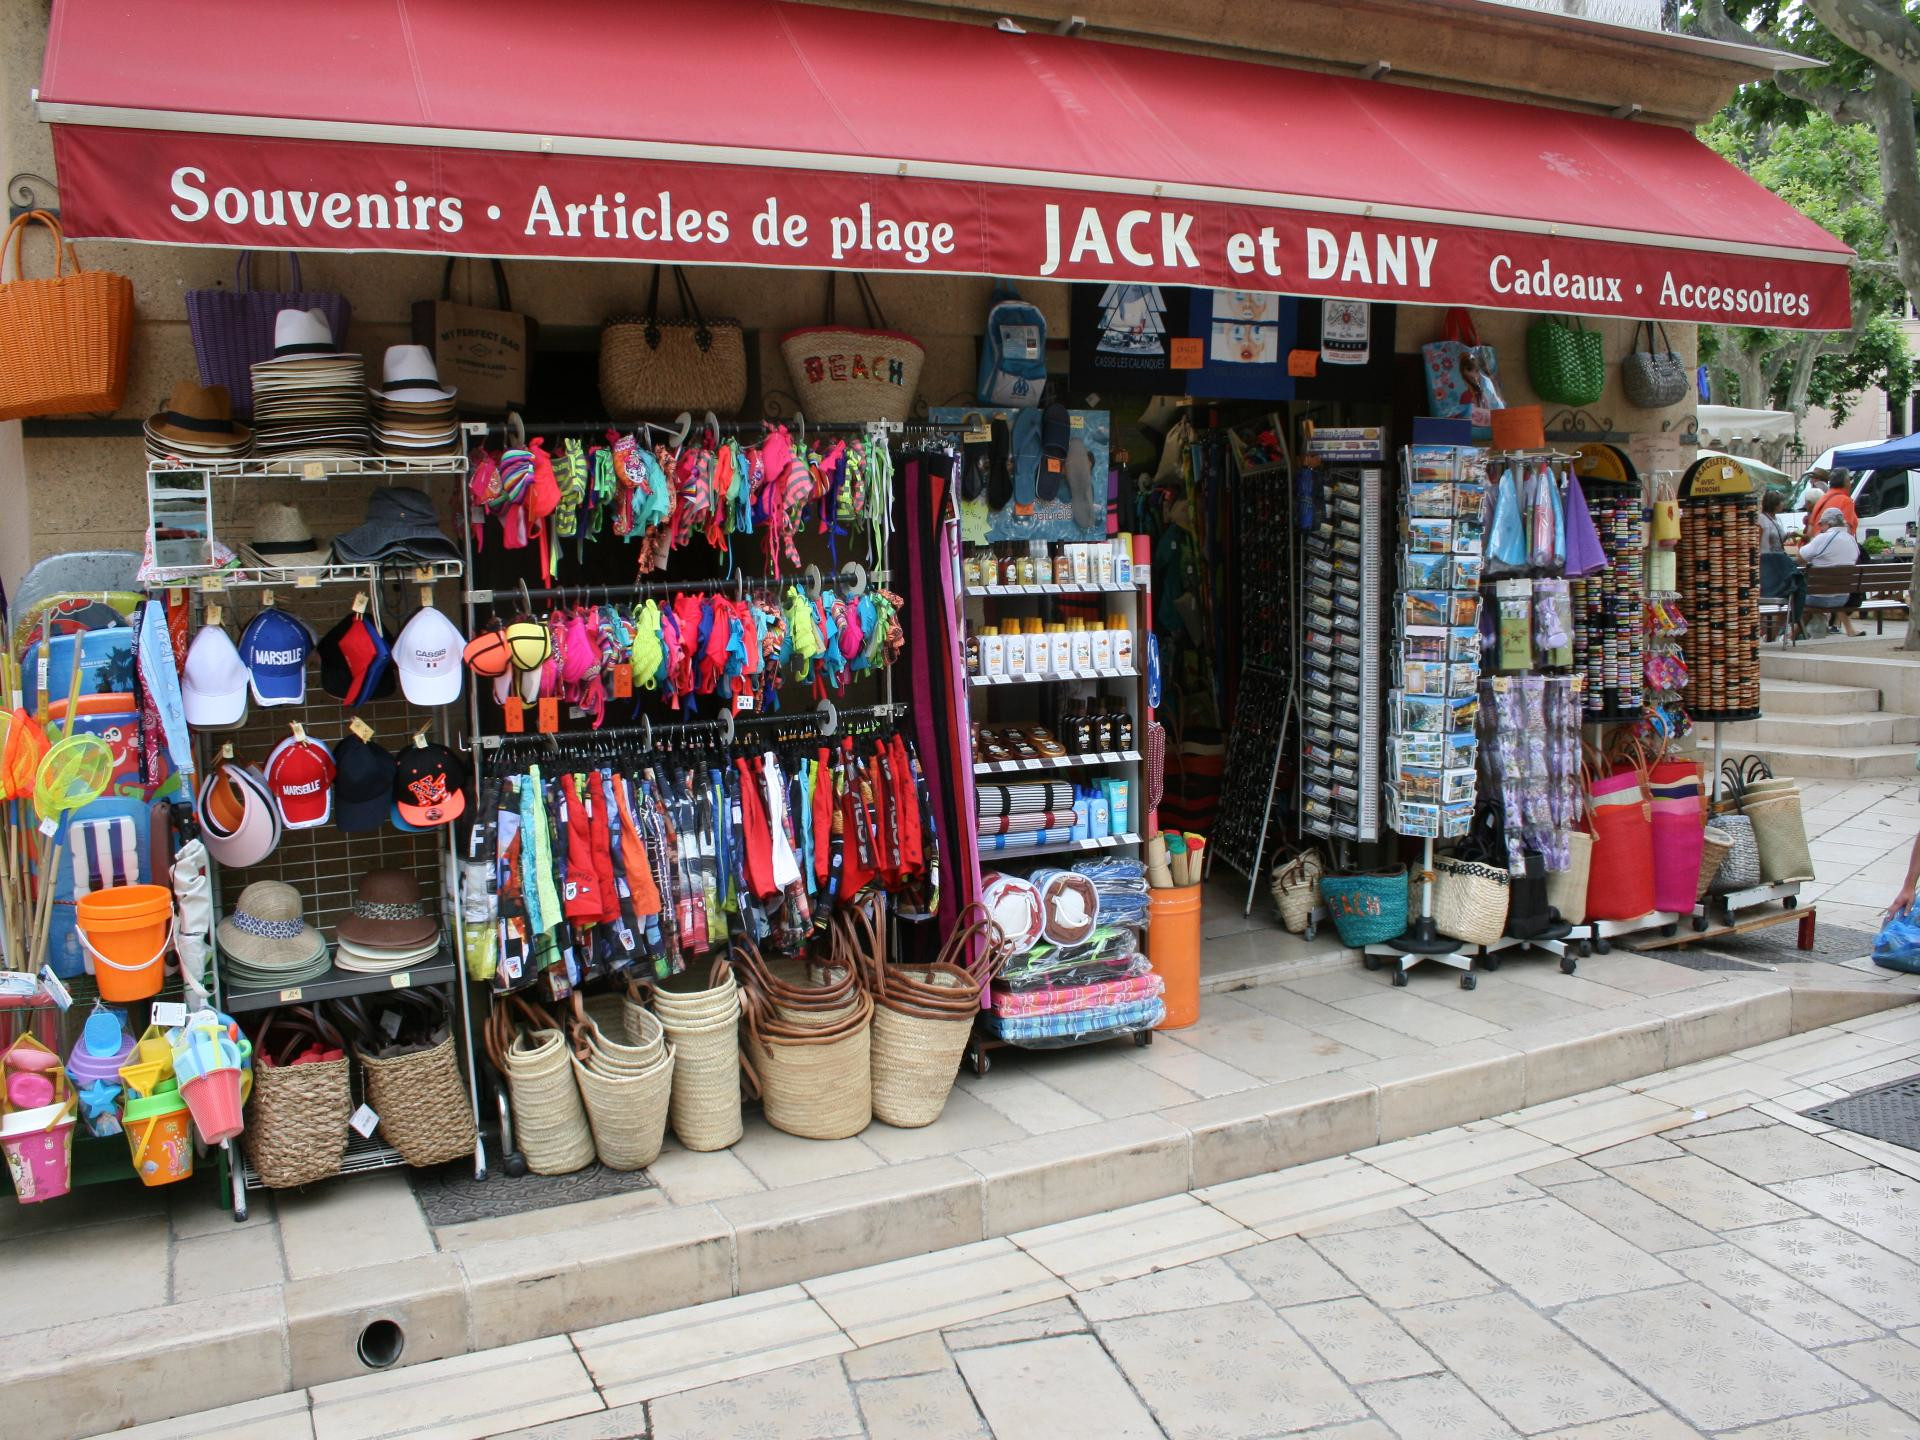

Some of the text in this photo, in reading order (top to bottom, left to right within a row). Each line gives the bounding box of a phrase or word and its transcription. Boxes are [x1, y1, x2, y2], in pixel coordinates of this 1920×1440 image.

[170, 166, 464, 233] Souvenirs
[524, 185, 955, 264] Articles de plage
[1040, 203, 1439, 287] JACK et DANY
[1489, 254, 1810, 316] Cadeaux Accessoires
[456, 328, 498, 342] PERFECT
[803, 354, 904, 387] BEACH
[1094, 356, 1166, 370] CASSIS LES CALANQUES
[1728, 459, 1744, 476] CUIR
[255, 647, 302, 666] MARSEILLE
[415, 648, 446, 657] CASSIS
[282, 779, 321, 796] MARSEILLE
